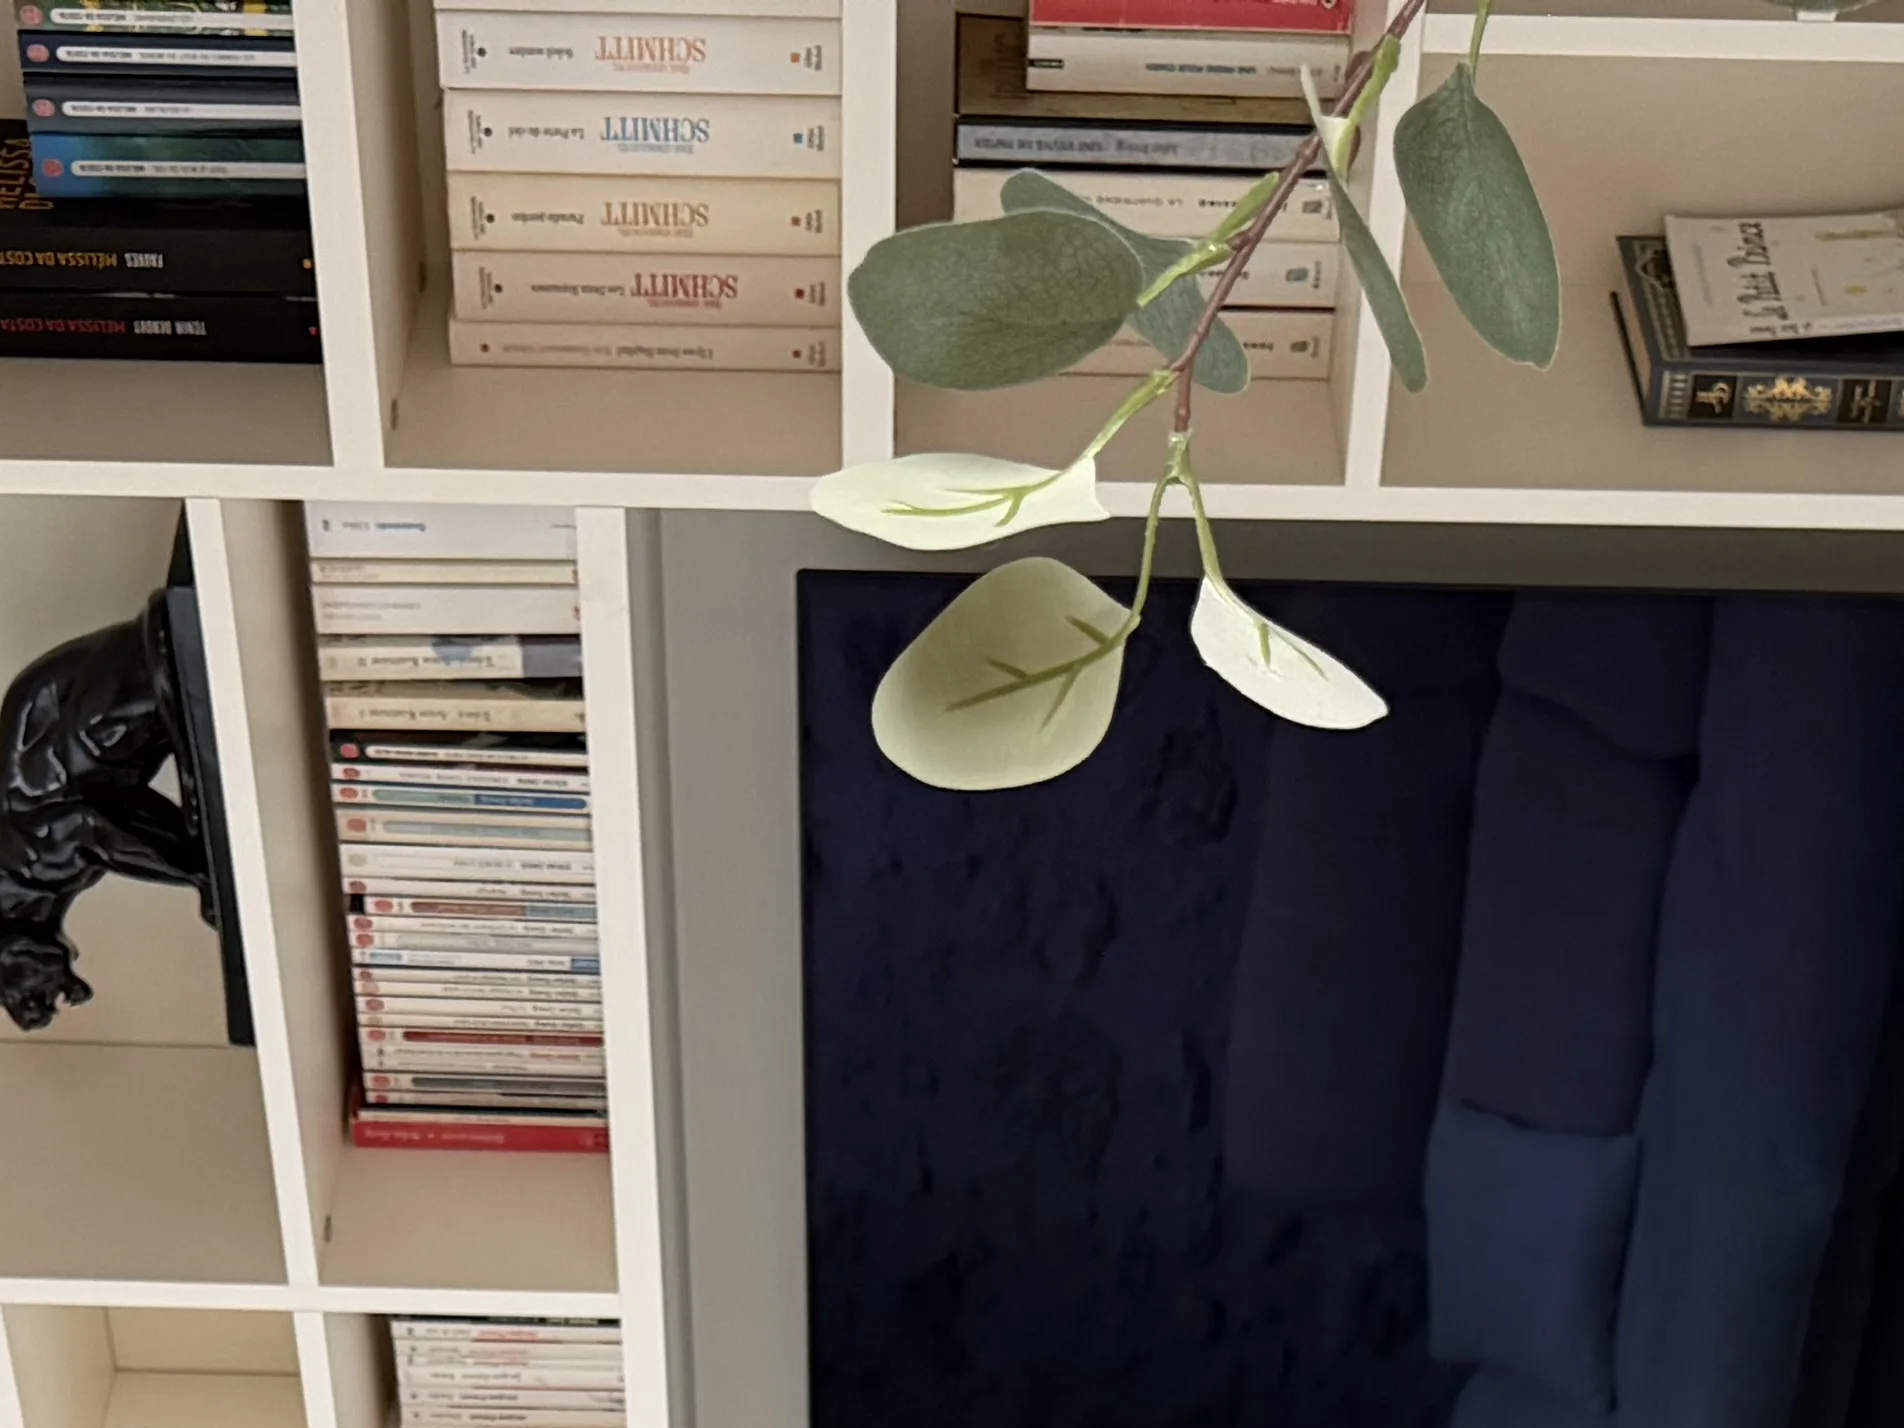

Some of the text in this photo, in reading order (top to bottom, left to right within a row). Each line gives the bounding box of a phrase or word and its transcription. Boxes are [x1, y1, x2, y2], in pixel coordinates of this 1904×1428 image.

[595, 36, 706, 62] SCHMITT
[508, 126, 527, 138] ciel
[544, 127, 570, 139] Porte
[572, 128, 585, 139] La
[601, 116, 710, 142] SCHMITT
[600, 201, 710, 227] SCHMITT
[1726, 221, 1772, 269] Prince
[36, 251, 55, 265] DA
[57, 252, 117, 270] MÉLISSA
[609, 285, 626, 296] Les
[630, 272, 739, 299] SCHMITT
[1733, 270, 1783, 304] Petit
[0, 317, 42, 331] COSTA
[45, 318, 63, 332] DA
[66, 319, 126, 334] MÉLISSA
